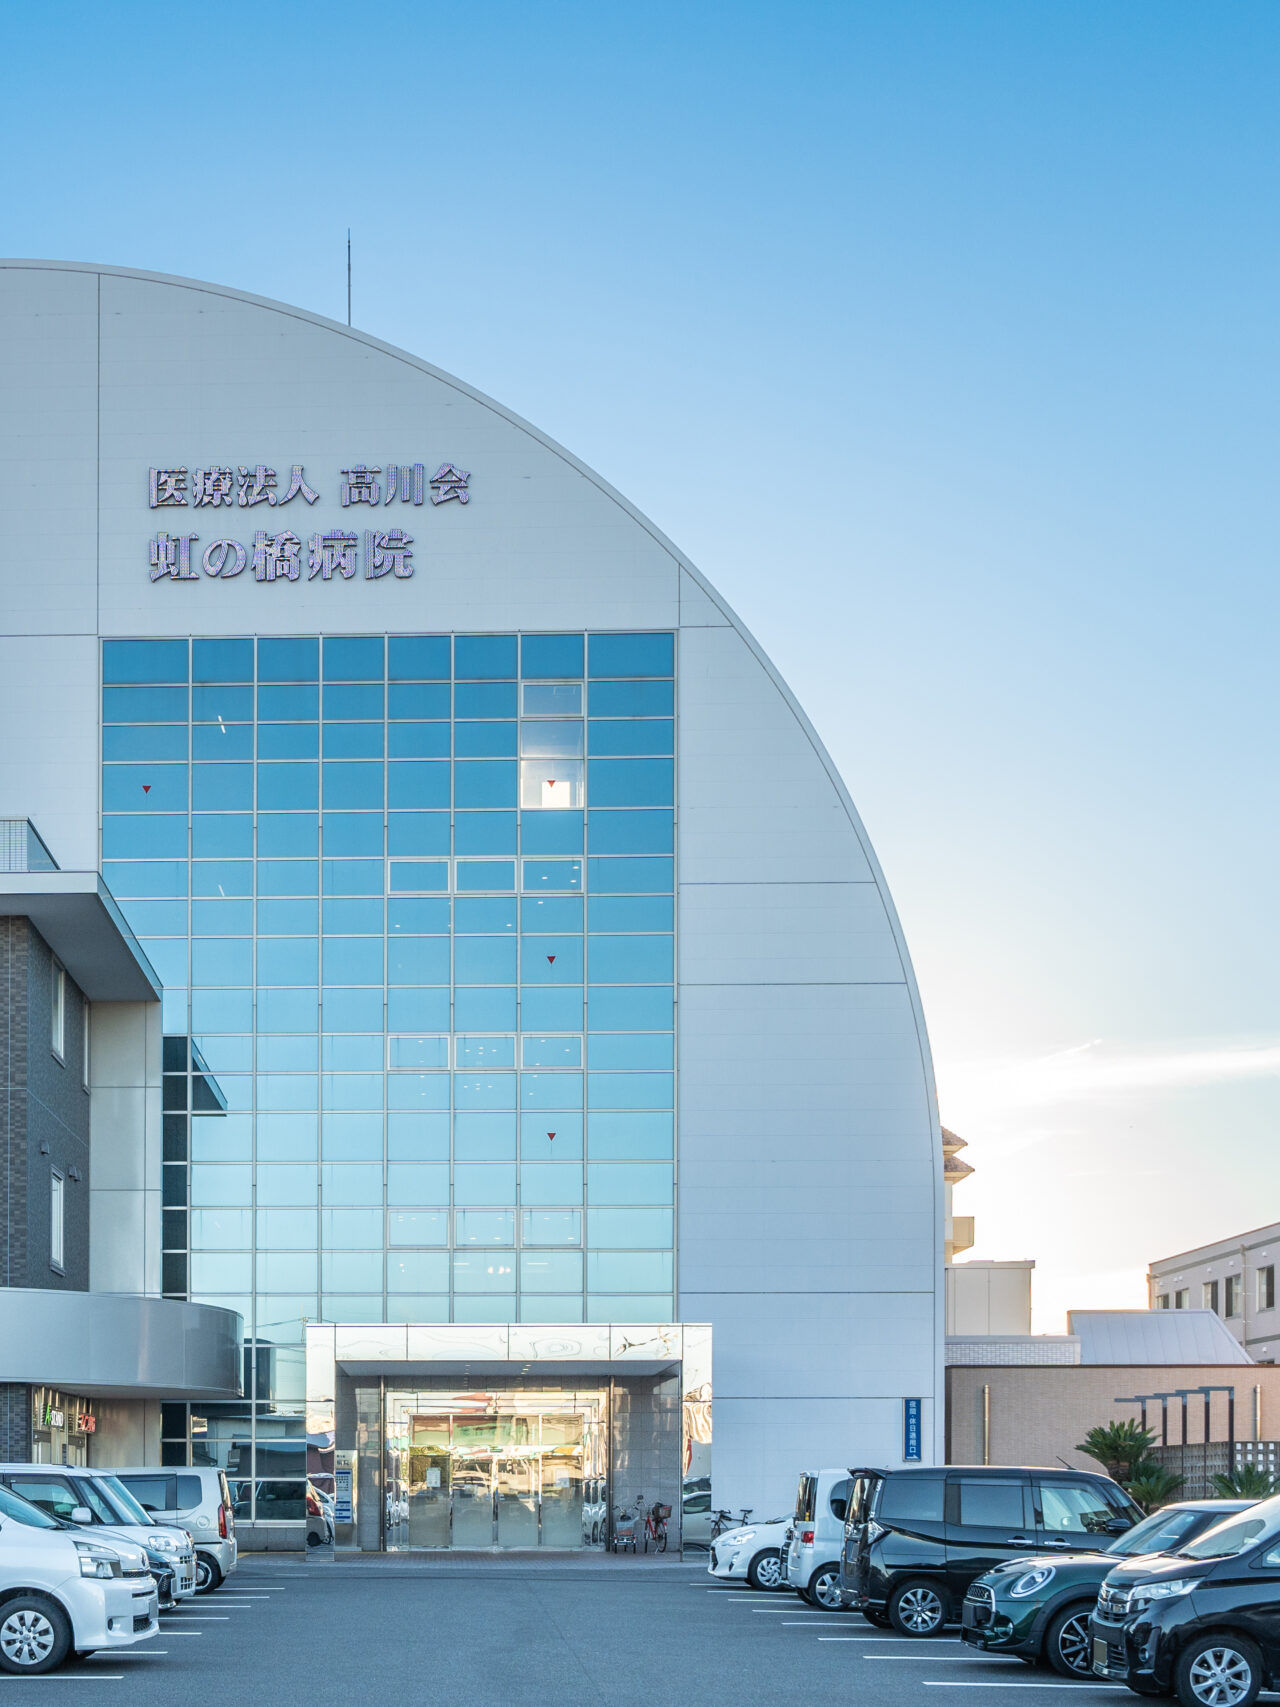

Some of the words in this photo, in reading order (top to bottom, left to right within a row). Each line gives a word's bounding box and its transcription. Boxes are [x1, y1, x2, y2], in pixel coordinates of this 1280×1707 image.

[148, 464, 320, 509] 医療法人
[148, 528, 416, 583] 虹の橋病院
